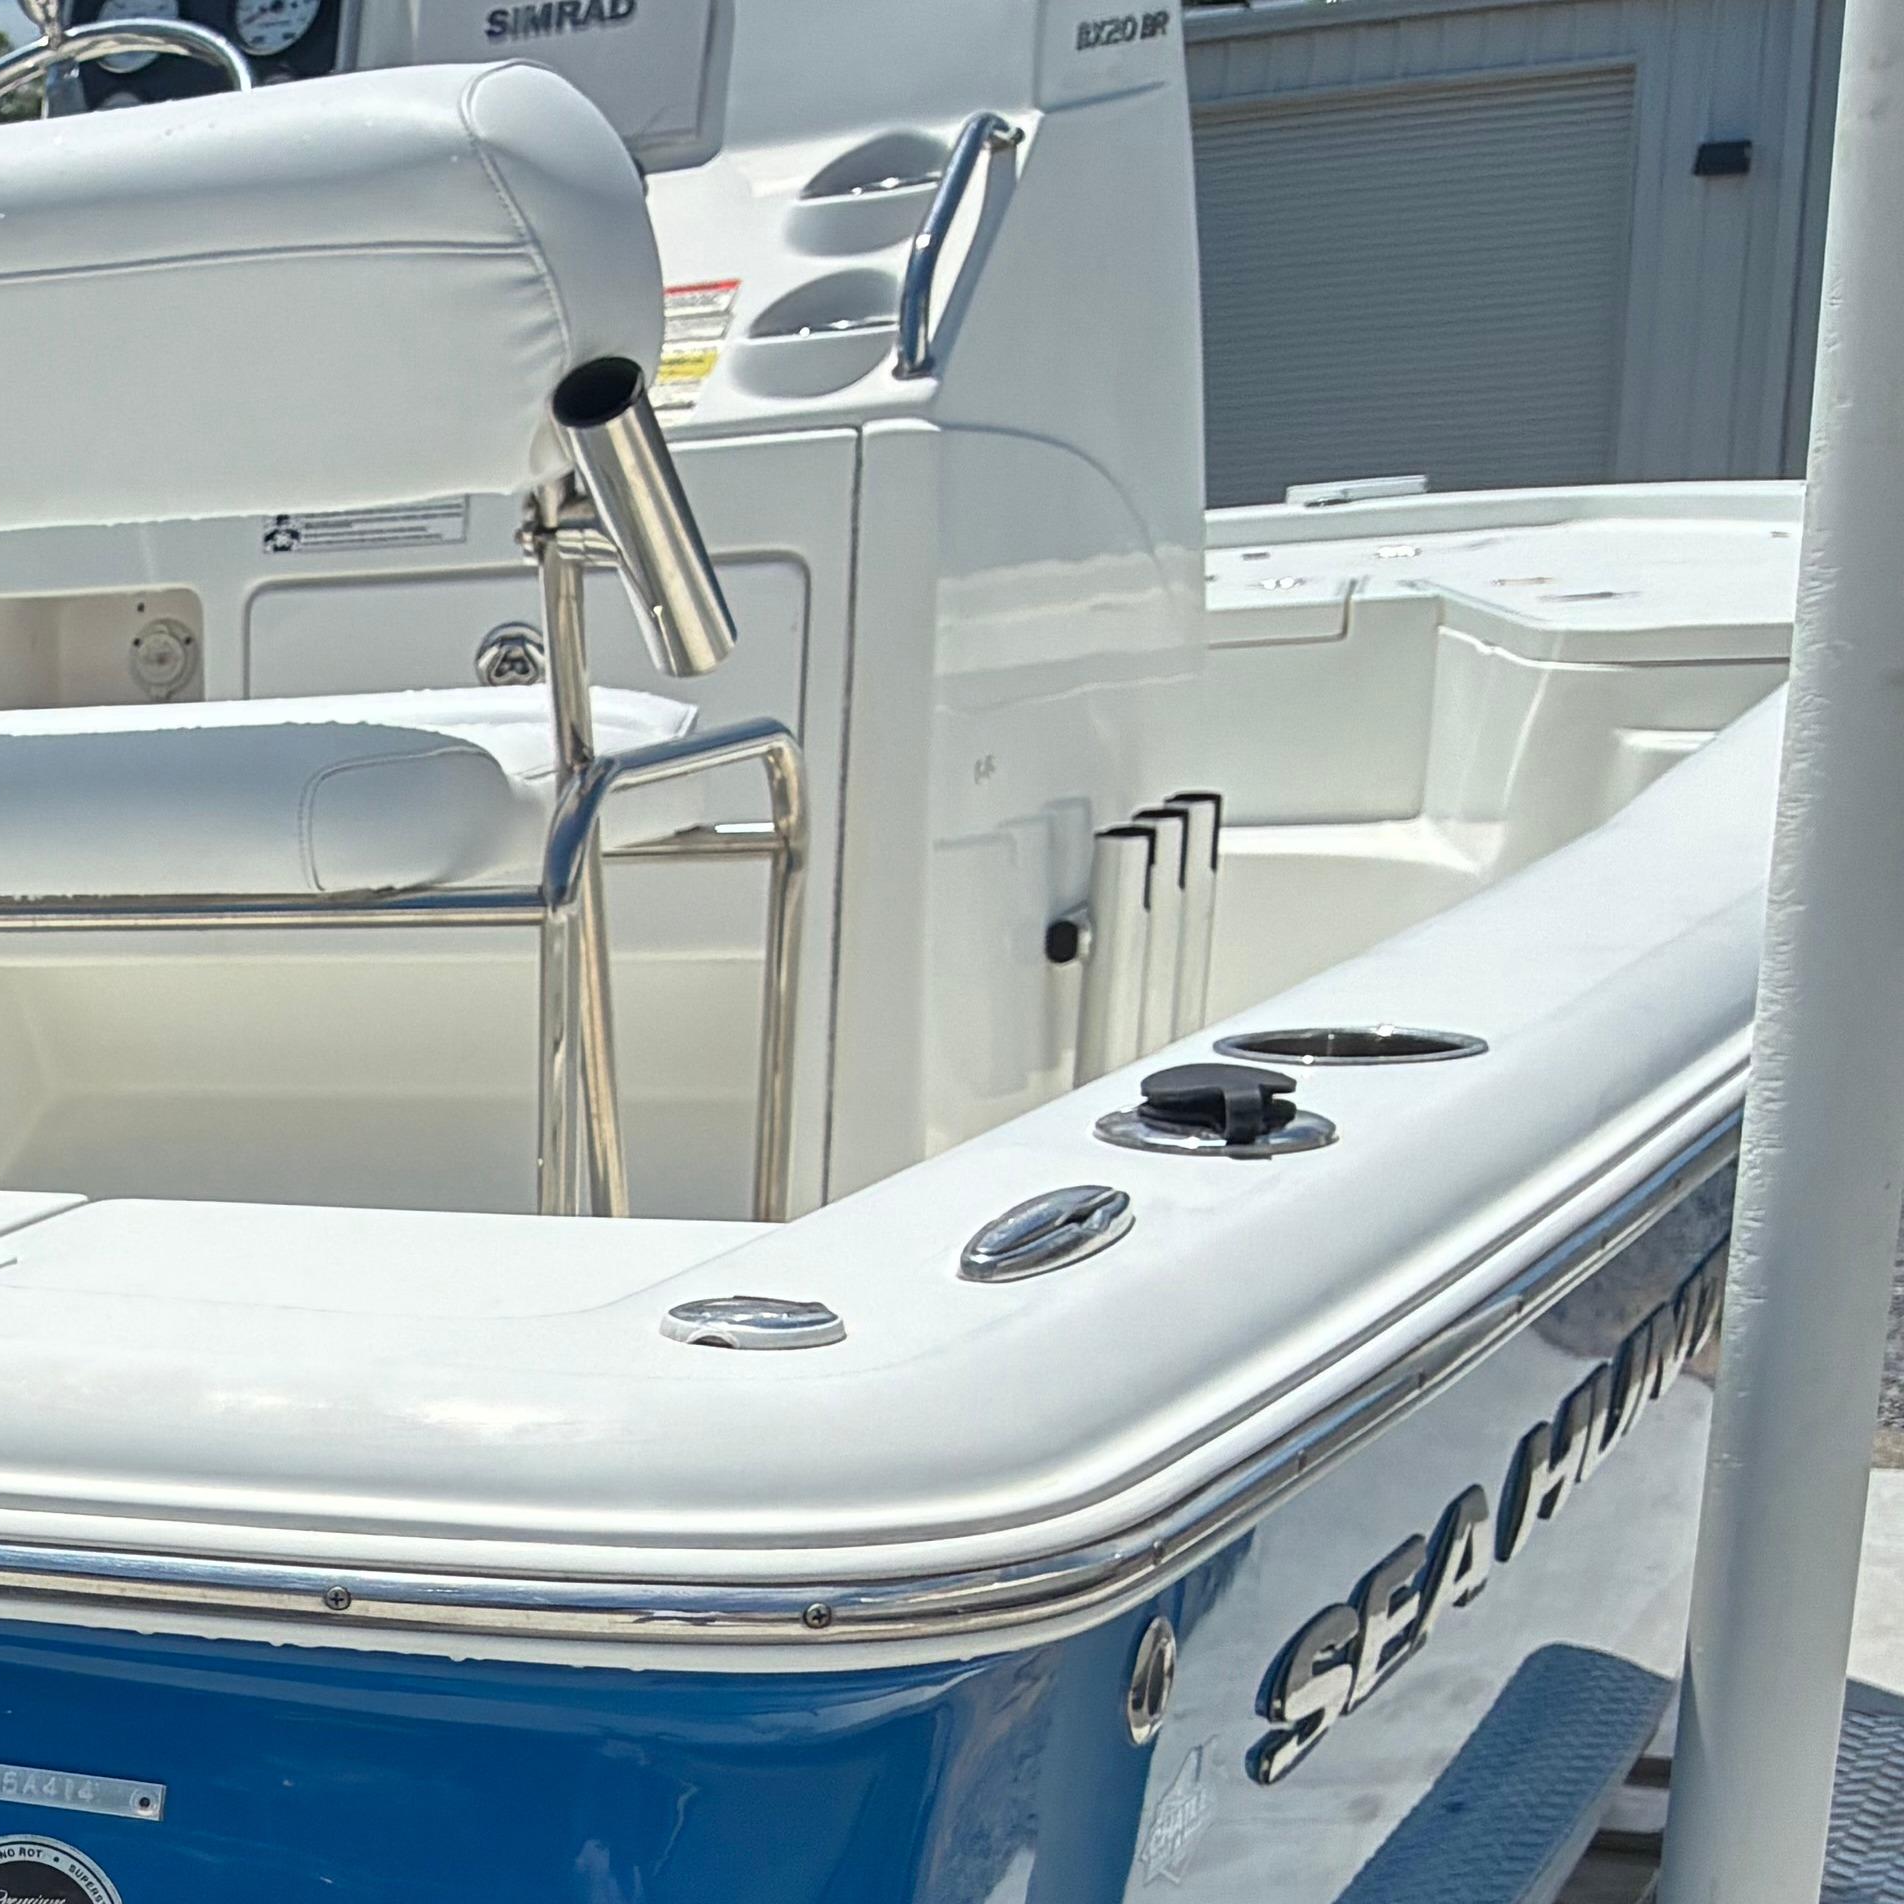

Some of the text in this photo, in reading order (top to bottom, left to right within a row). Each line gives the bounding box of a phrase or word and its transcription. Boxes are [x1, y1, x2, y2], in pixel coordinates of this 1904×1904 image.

[484, 0, 637, 39] SIMRAD
[1245, 1483, 1490, 1786] SEA
[18, 1847, 44, 1859] ROT
